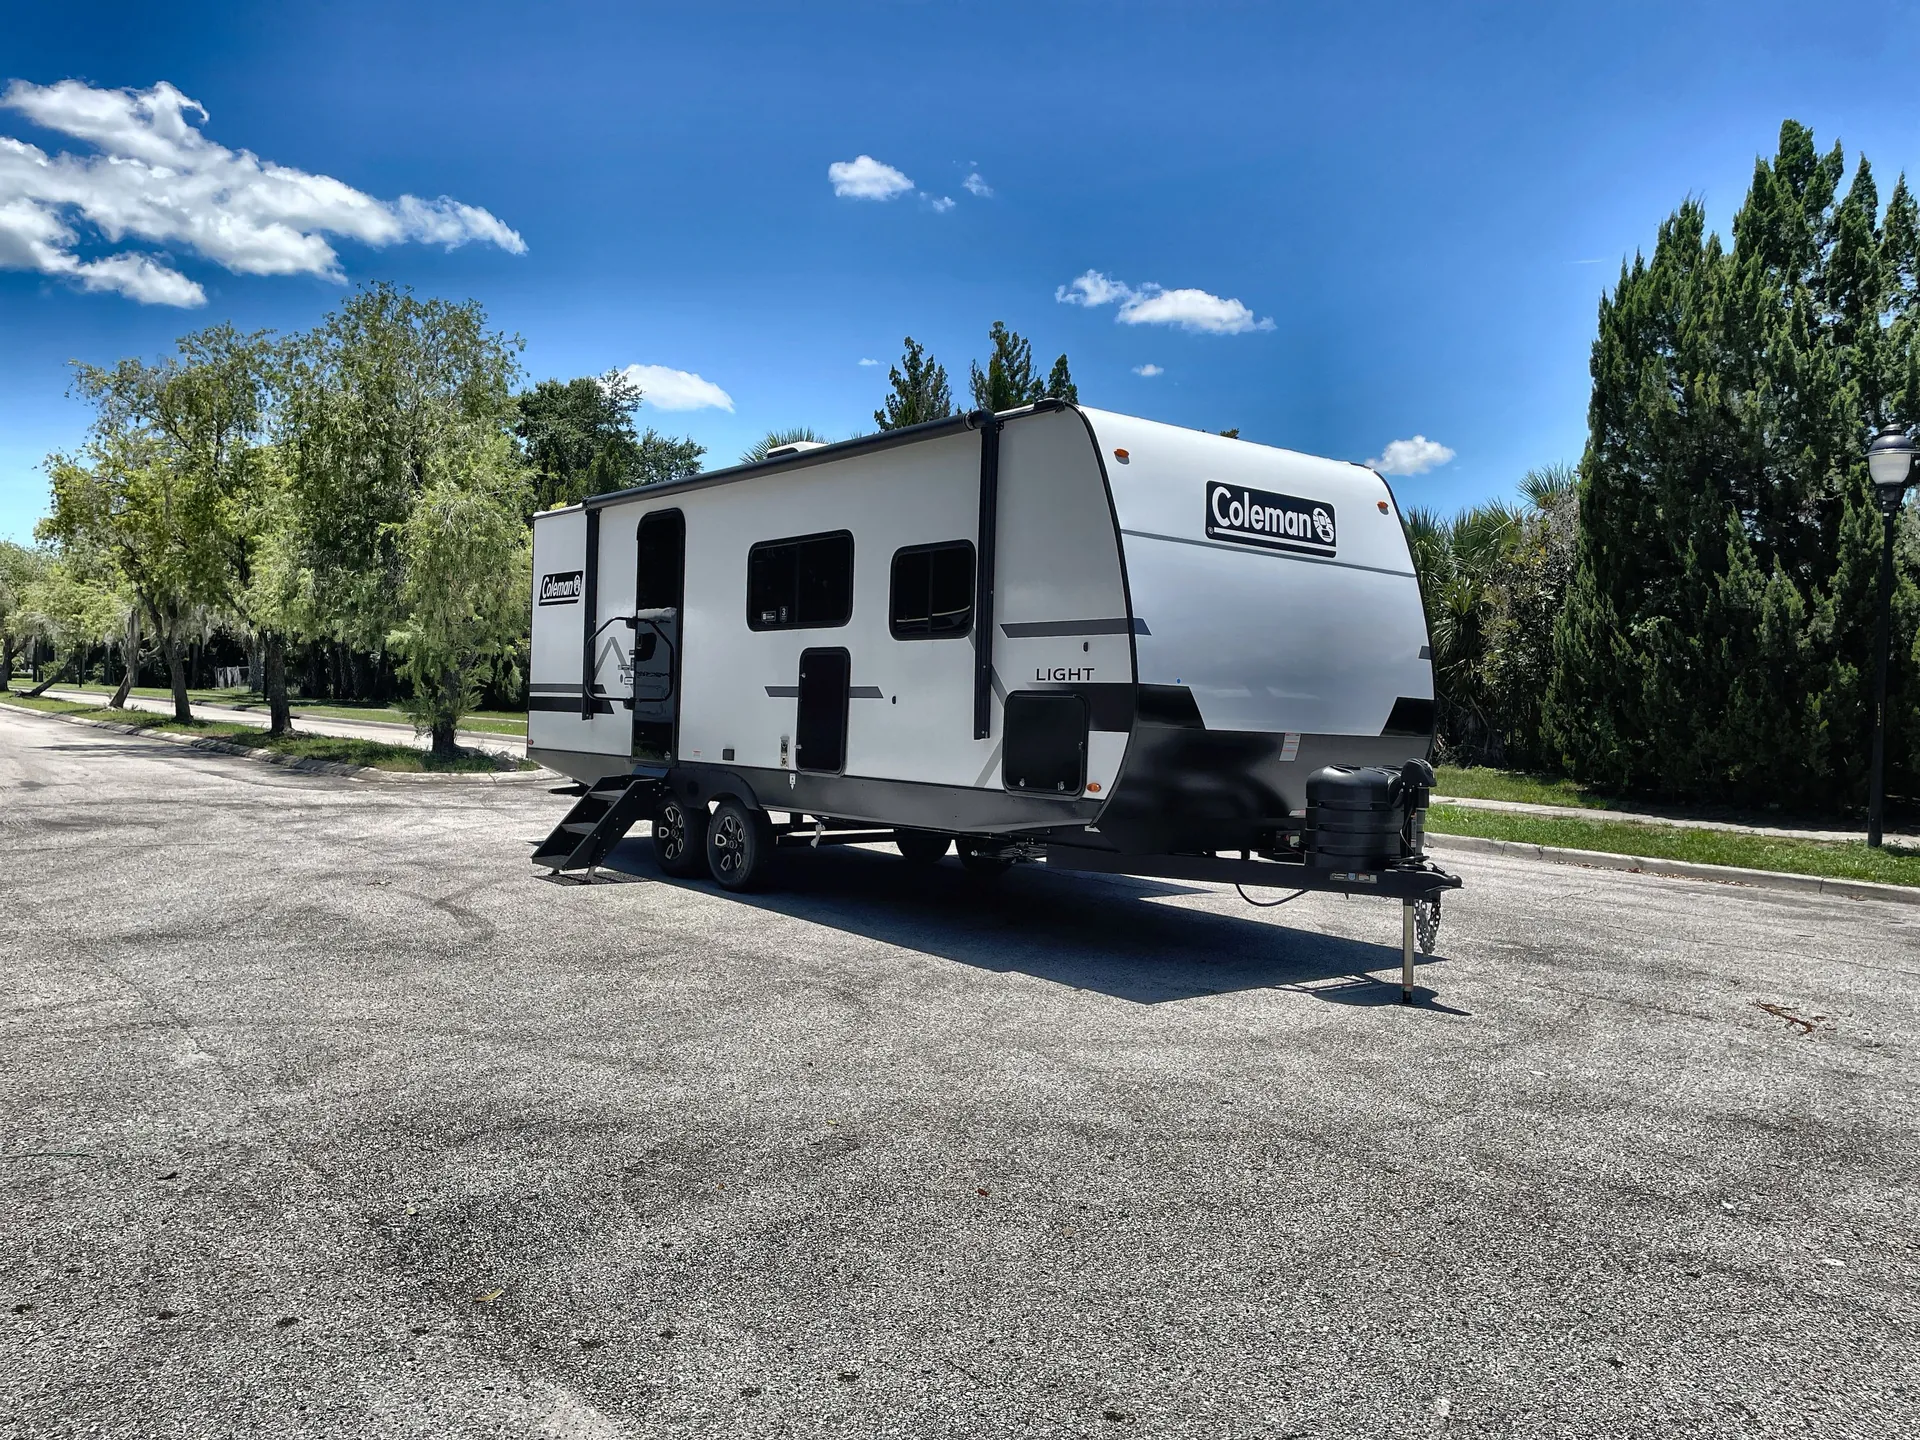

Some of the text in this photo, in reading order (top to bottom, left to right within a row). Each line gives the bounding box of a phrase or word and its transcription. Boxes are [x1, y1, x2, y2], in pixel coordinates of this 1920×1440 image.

[1212, 486, 1312, 538] Coleman
[542, 576, 573, 598] Coleman
[781, 607, 786, 616] 3
[1036, 668, 1095, 681] LIGHT
